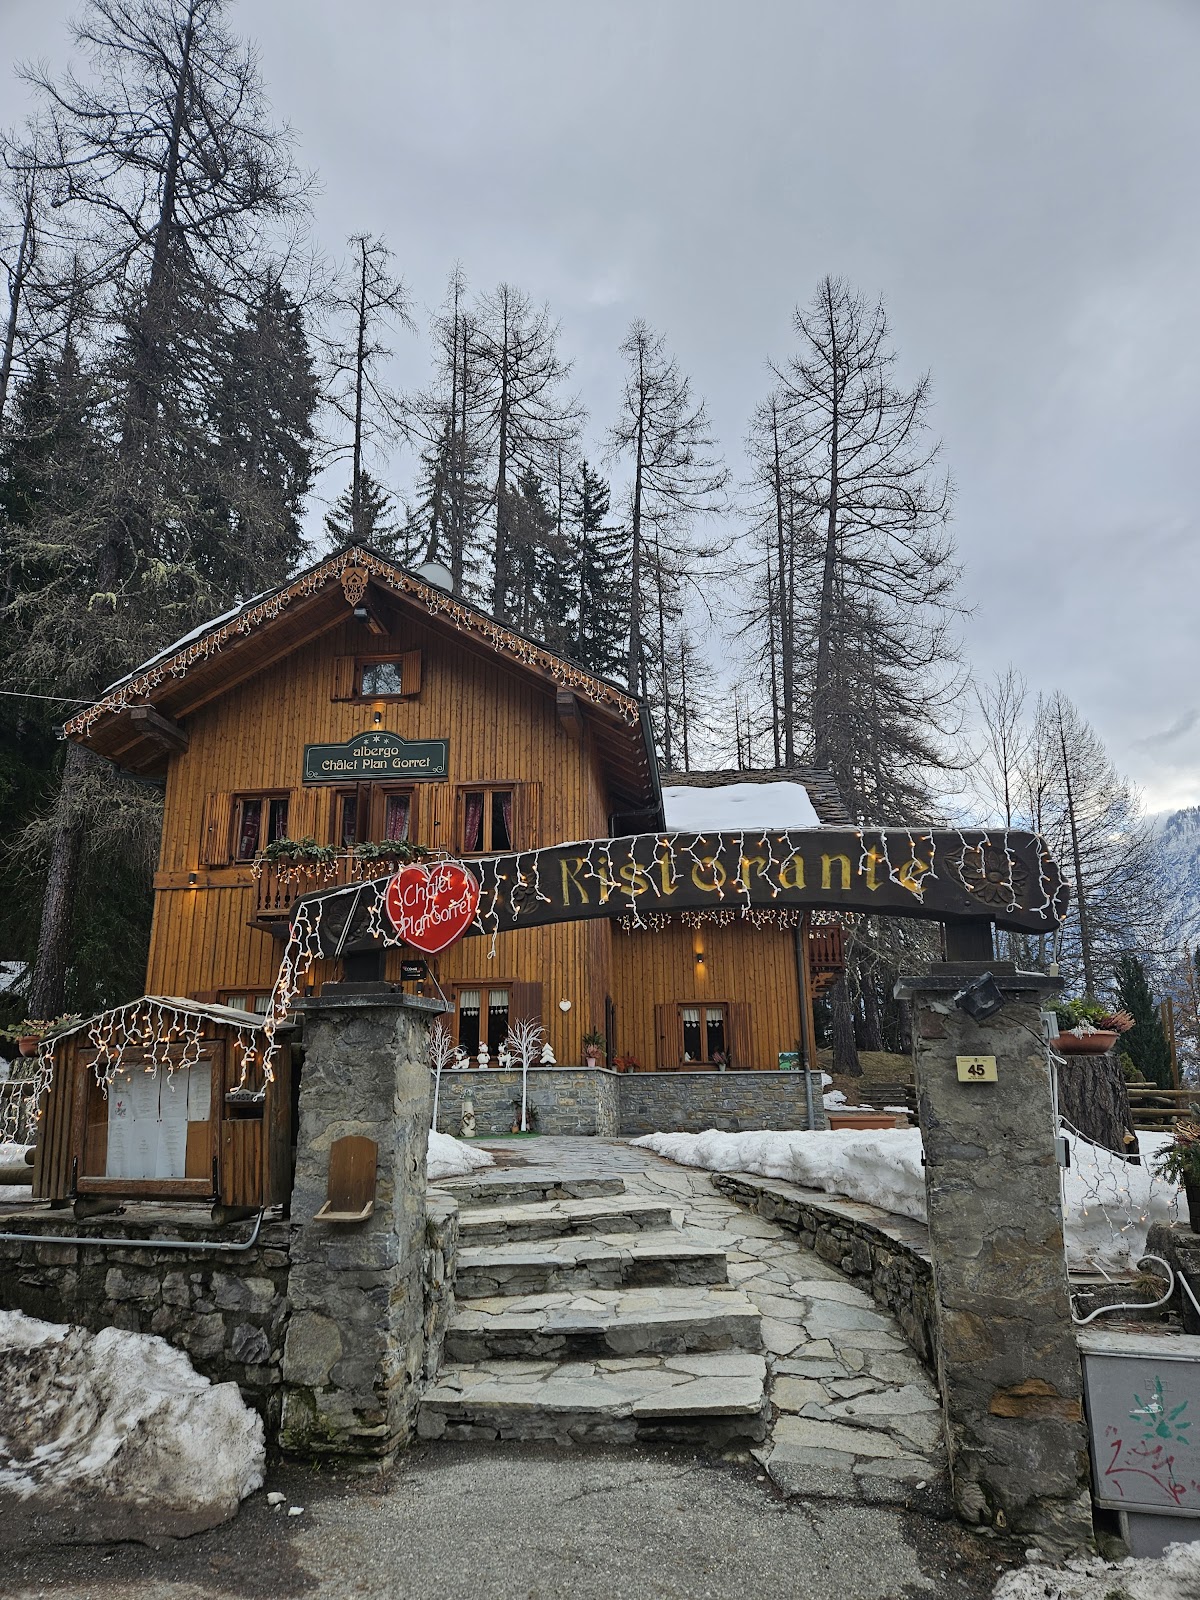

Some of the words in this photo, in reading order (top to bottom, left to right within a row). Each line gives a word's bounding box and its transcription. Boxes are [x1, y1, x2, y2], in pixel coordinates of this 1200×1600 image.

[352, 746, 399, 758] albergo
[321, 758, 358, 771] Châlet
[362, 758, 388, 769] Plan
[392, 757, 431, 768] Gorret
[557, 844, 929, 906] Ristorante
[404, 871, 453, 906] Chalet
[967, 1064, 986, 1076] 45
